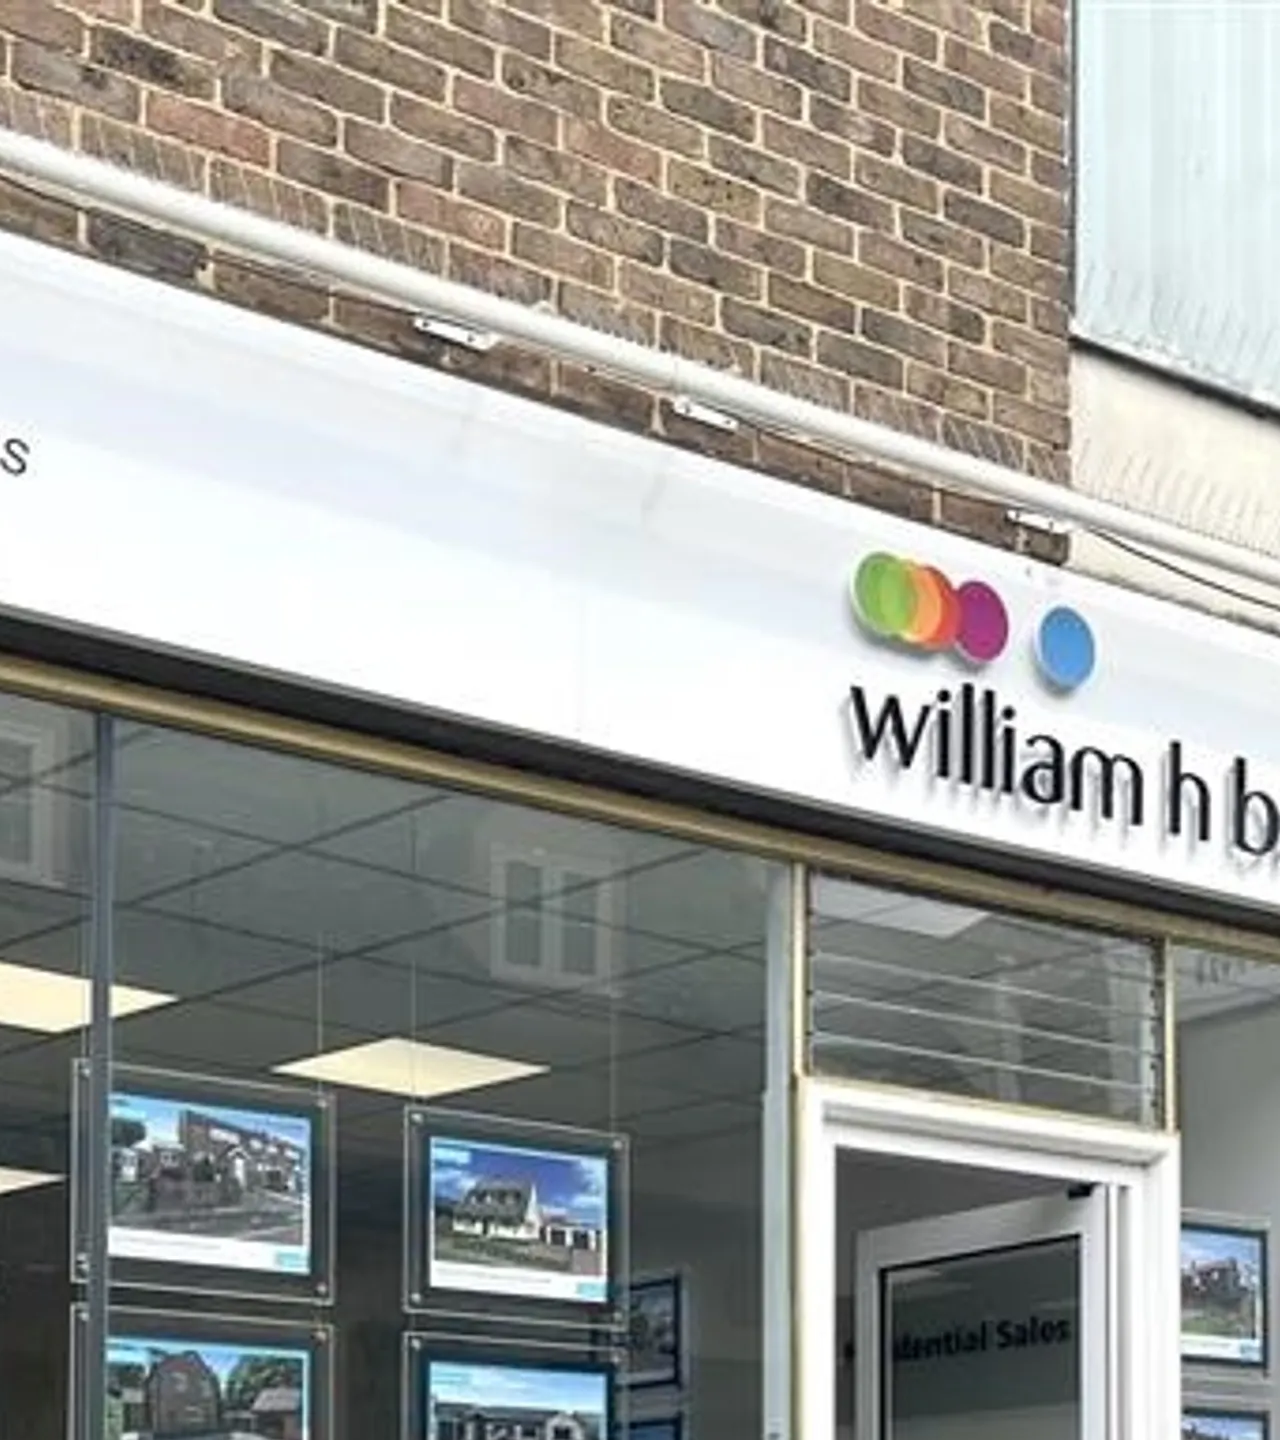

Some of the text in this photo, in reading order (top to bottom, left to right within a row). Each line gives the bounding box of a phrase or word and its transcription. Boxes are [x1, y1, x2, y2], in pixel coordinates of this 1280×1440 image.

[850, 682, 1142, 828] william
[1167, 741, 1212, 842] h
[997, 1316, 1072, 1348] Sales
